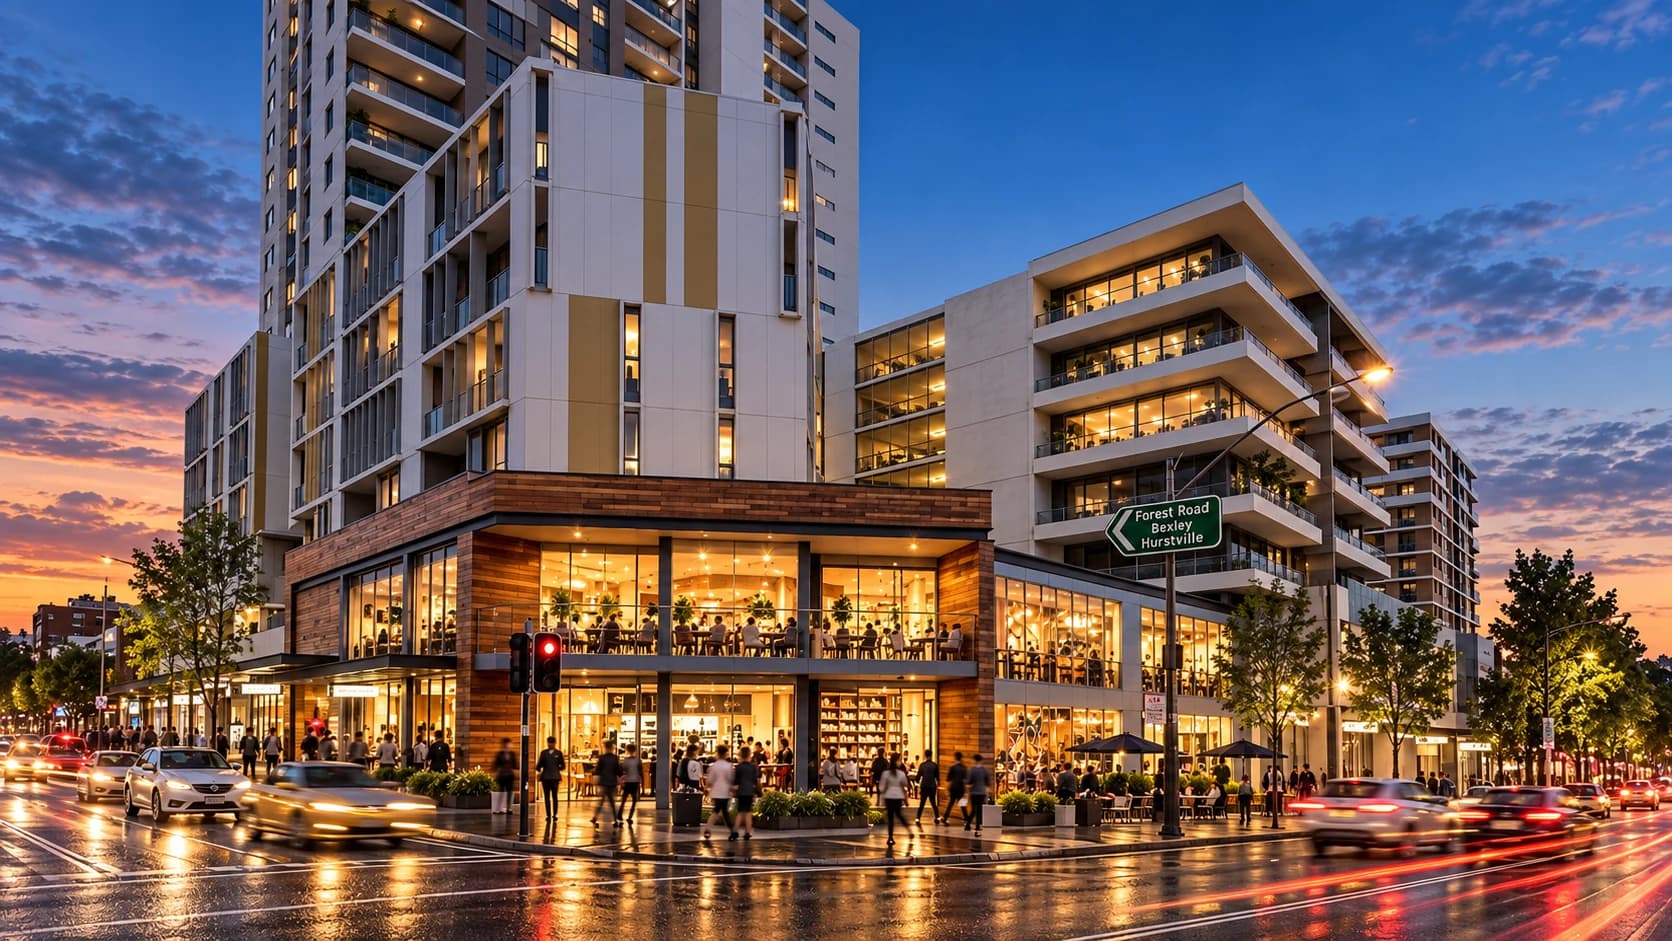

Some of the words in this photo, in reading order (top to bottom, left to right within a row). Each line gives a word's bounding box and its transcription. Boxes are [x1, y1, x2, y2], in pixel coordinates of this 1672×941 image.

[1135, 507, 1174, 522] Forest
[1178, 502, 1210, 516] Road
[1151, 520, 1193, 534] Bexley
[1141, 532, 1204, 549] Hurstville
